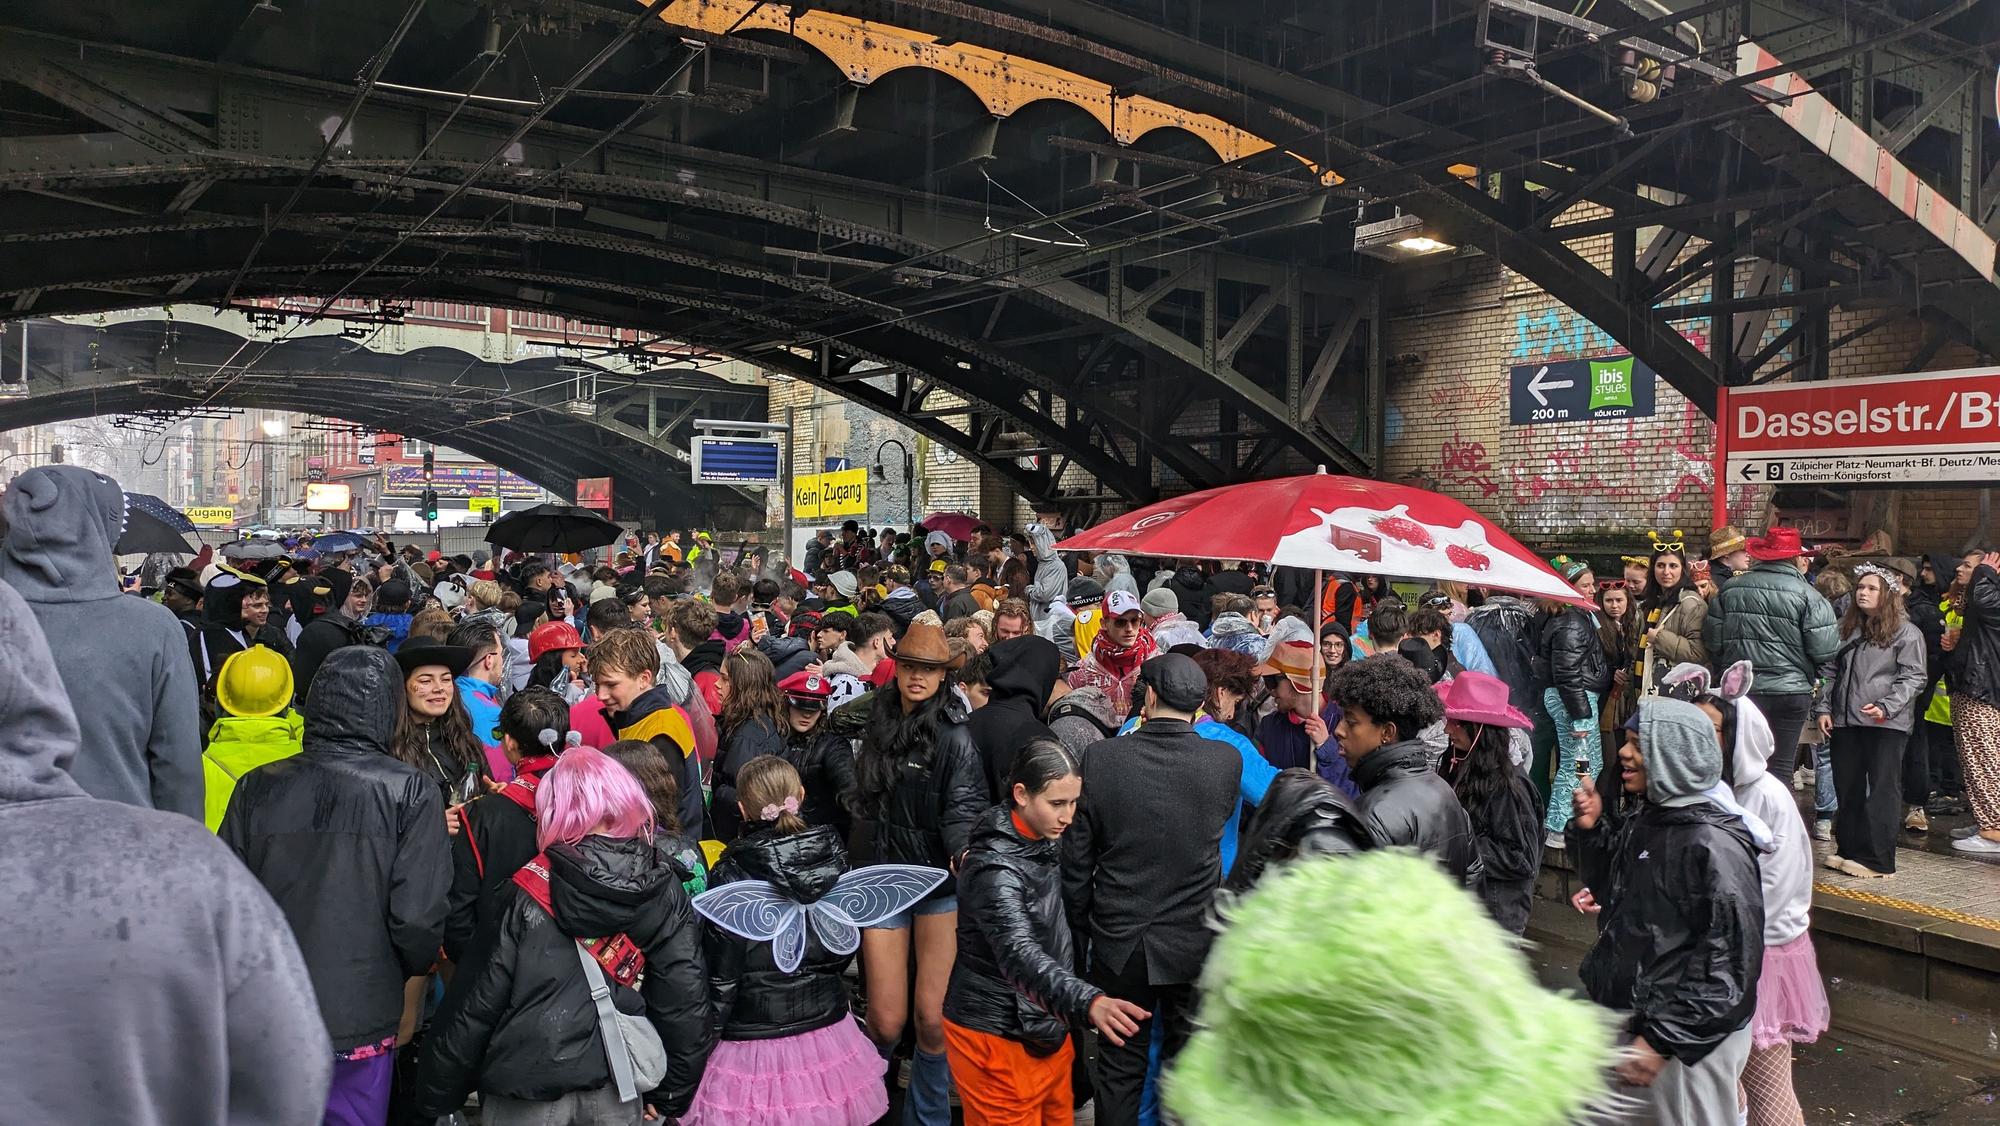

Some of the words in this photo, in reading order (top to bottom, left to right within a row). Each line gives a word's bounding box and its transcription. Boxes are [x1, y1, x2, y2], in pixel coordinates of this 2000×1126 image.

[1600, 368, 1623, 384] ibis
[1532, 408, 1554, 420] 200
[1557, 409, 1569, 418] m
[1594, 409, 1611, 417] KÖLN
[1770, 465, 1779, 479] 9
[1790, 461, 1833, 472] Zülpicher
[1790, 471, 1891, 483] Ostheim-Königsforst
[796, 487, 817, 506] Kein
[823, 482, 861, 506] Zugang
[186, 508, 232, 520] Zugang
